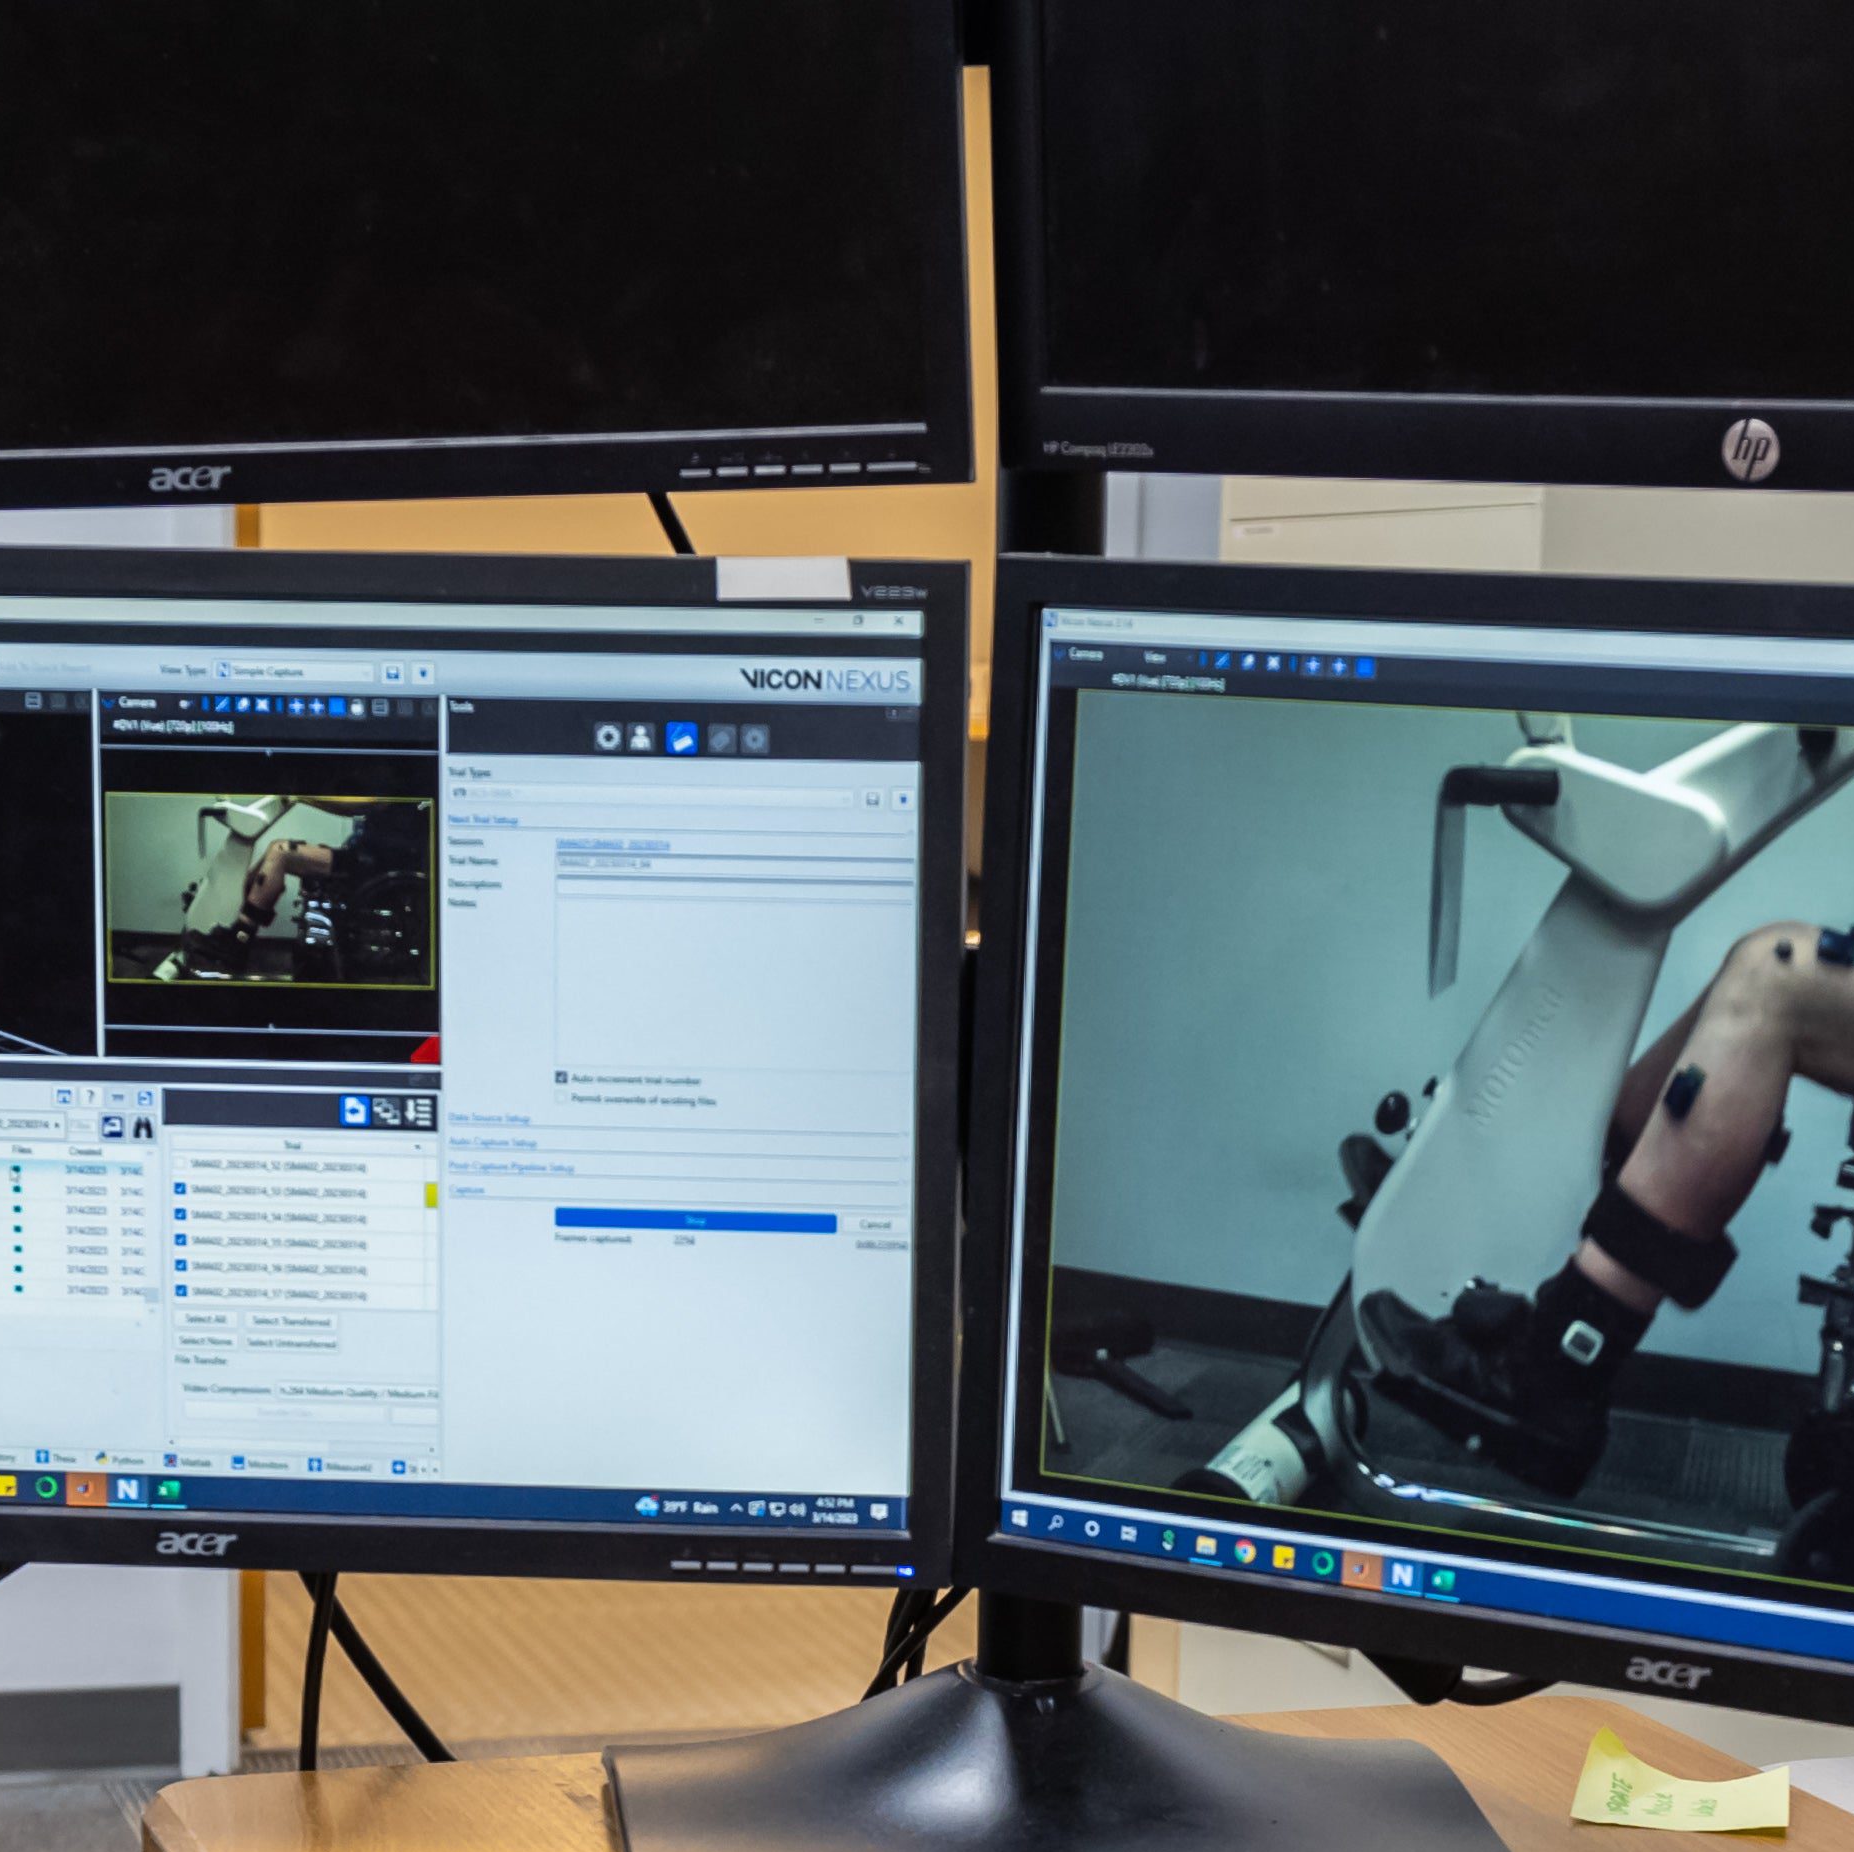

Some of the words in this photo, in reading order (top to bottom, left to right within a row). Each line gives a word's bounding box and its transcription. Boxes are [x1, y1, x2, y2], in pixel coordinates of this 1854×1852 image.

[1726, 418, 1775, 482] hp
[148, 465, 232, 491] acer
[740, 667, 823, 690] VICON
[826, 669, 911, 693] NEXUS
[117, 695, 157, 710] Camera
[571, 1072, 594, 1085] Auto
[595, 1072, 642, 1086] increment
[643, 1073, 663, 1086] trial
[664, 1074, 702, 1087] number
[859, 1218, 892, 1232] Cancel
[184, 1314, 210, 1324] Select
[252, 1316, 279, 1326] Select
[282, 1317, 332, 1328] Transferred
[178, 1336, 205, 1347] Select
[207, 1337, 234, 1347] None
[247, 1338, 273, 1348] Select
[111, 1455, 145, 1467] Python
[692, 1501, 719, 1515] Rain
[155, 1530, 239, 1557] acer
[1625, 1655, 1712, 1690] acer
